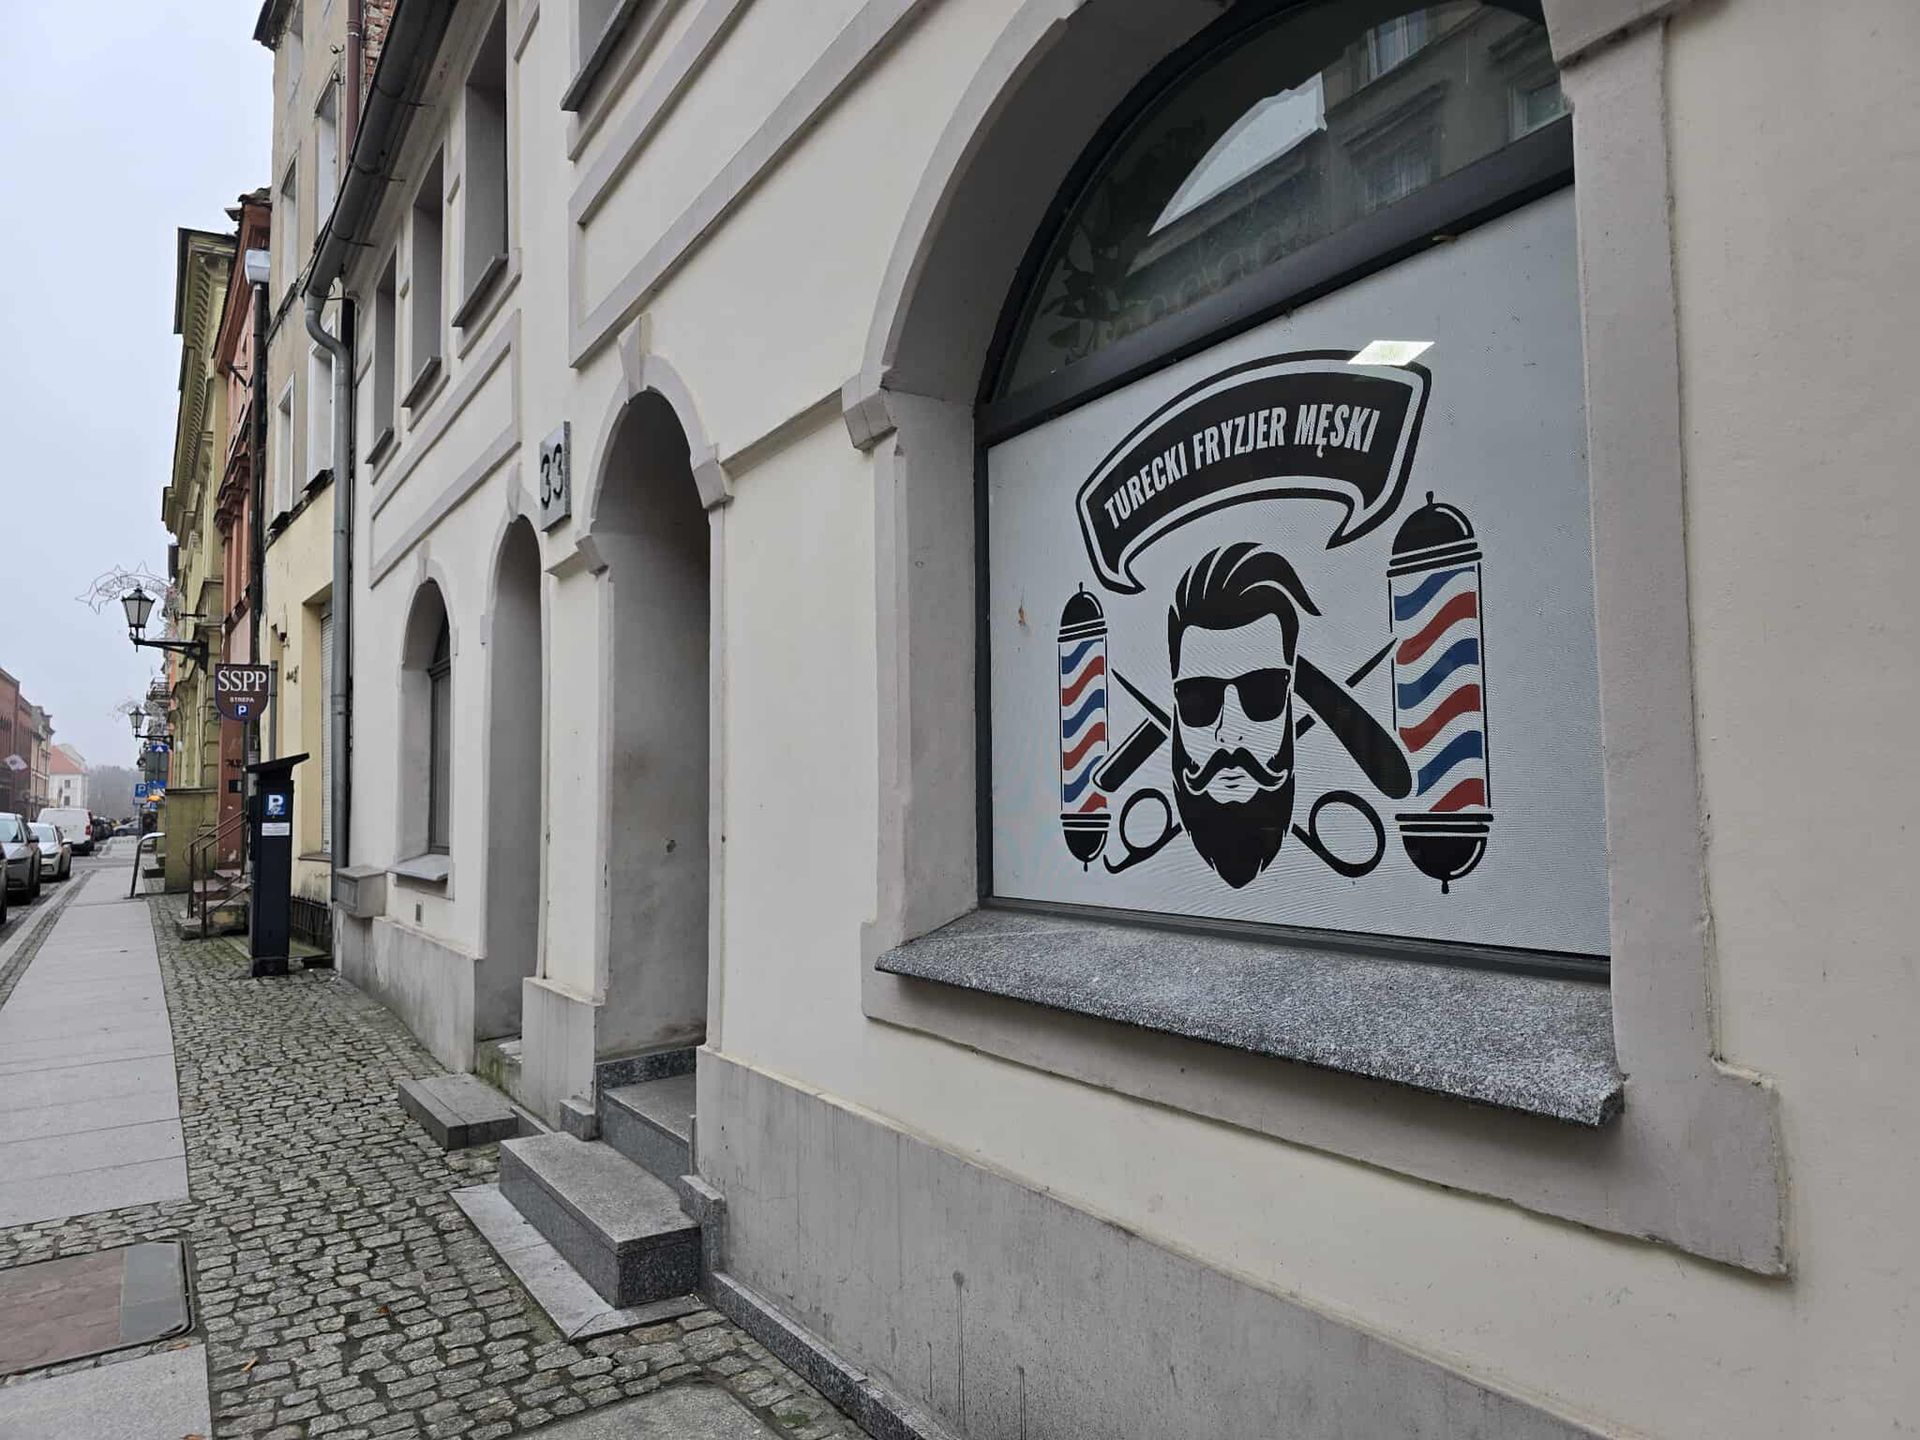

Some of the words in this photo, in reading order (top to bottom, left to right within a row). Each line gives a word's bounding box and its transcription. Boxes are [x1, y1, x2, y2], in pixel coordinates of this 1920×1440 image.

[541, 443, 563, 510] 33
[1104, 441, 1188, 529] TURECKI
[1193, 407, 1287, 470] FRYZJER
[1294, 404, 1380, 458] MĘSKI
[218, 666, 267, 691] ŚSPP
[238, 705, 247, 716] P
